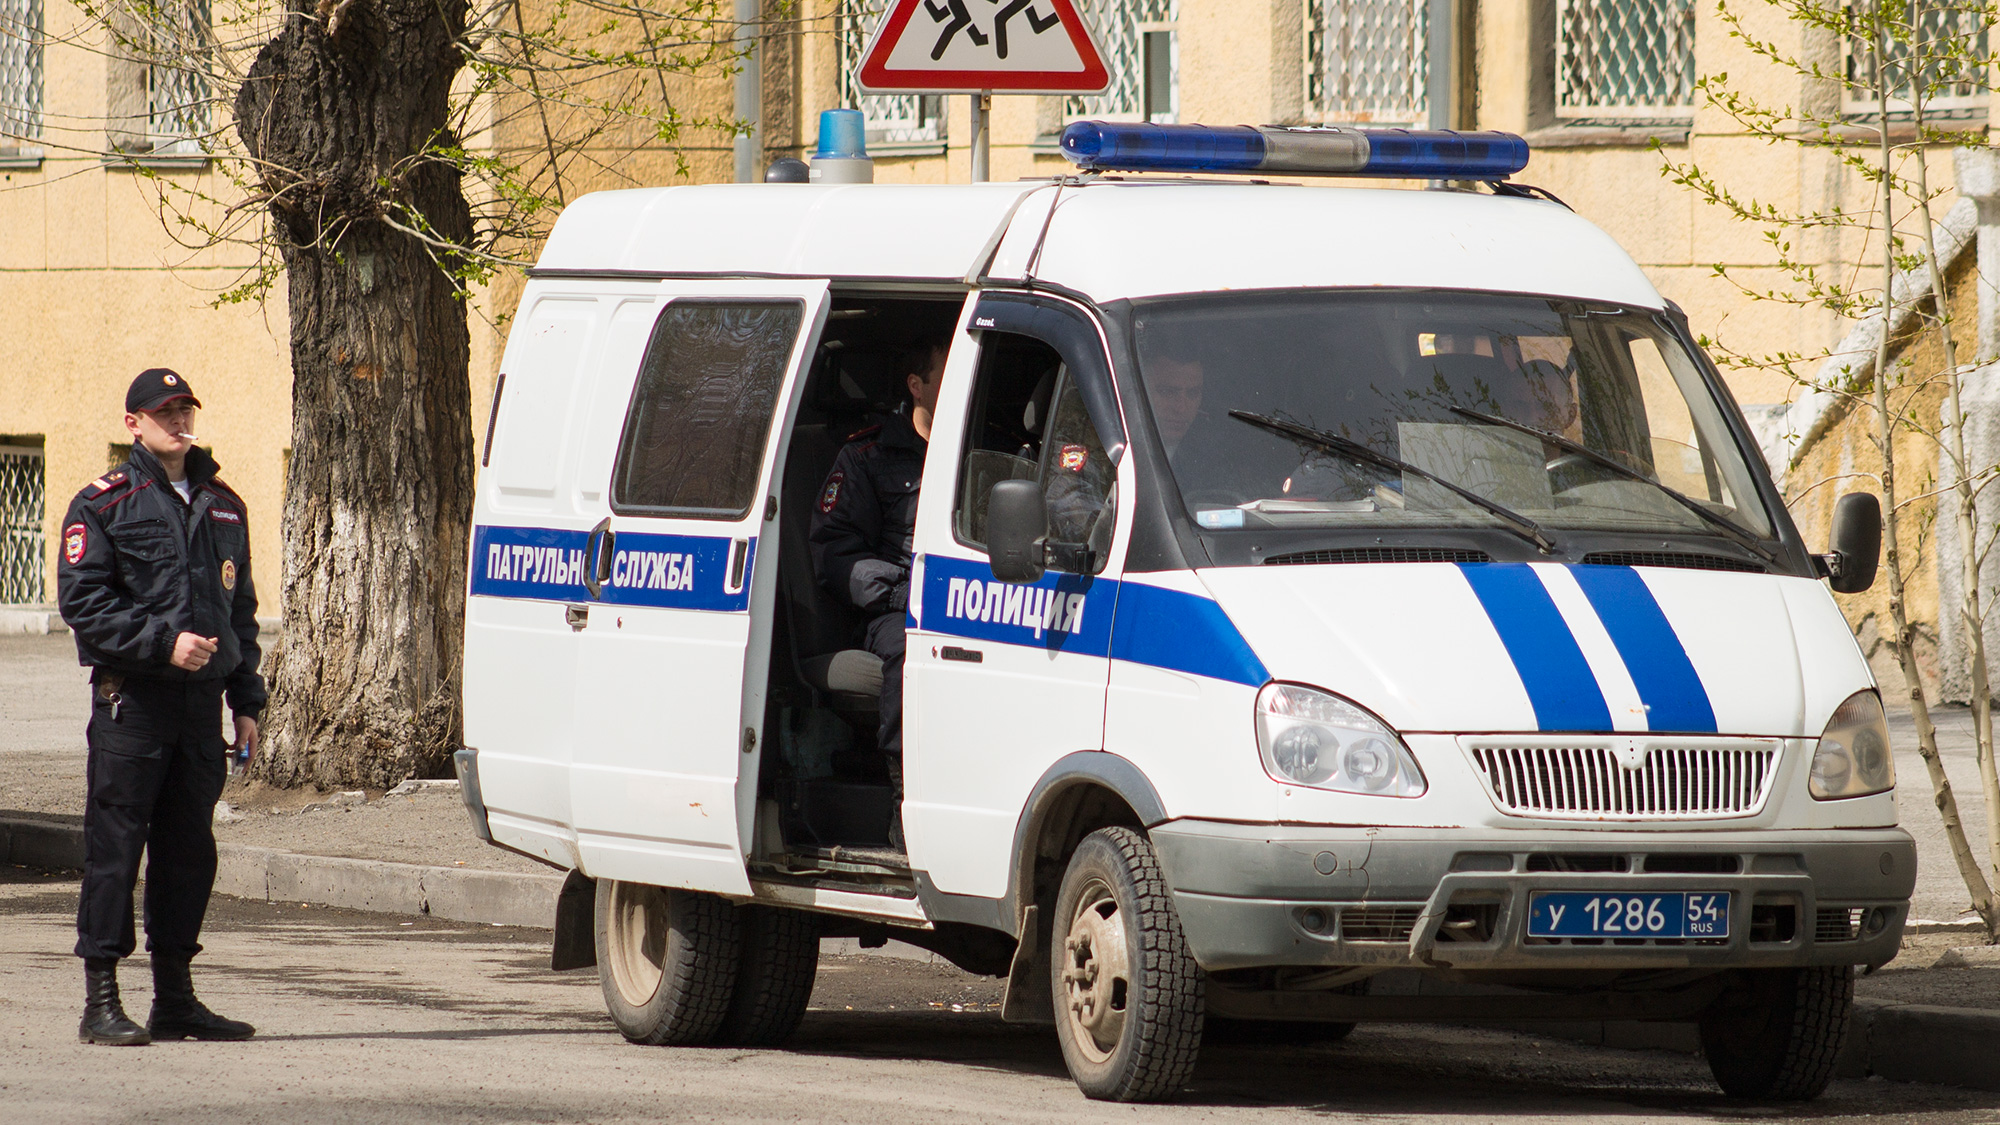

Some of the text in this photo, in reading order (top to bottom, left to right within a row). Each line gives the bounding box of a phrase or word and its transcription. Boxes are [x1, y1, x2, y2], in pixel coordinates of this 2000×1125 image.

[487, 543, 693, 591] ПАТРУЛЬН СЛУЖБА
[946, 577, 1086, 639] ПОЛИЦИЯ
[1584, 897, 1665, 931] 1286
[1687, 895, 1717, 921] 54
[1690, 922, 1713, 933] RUS
